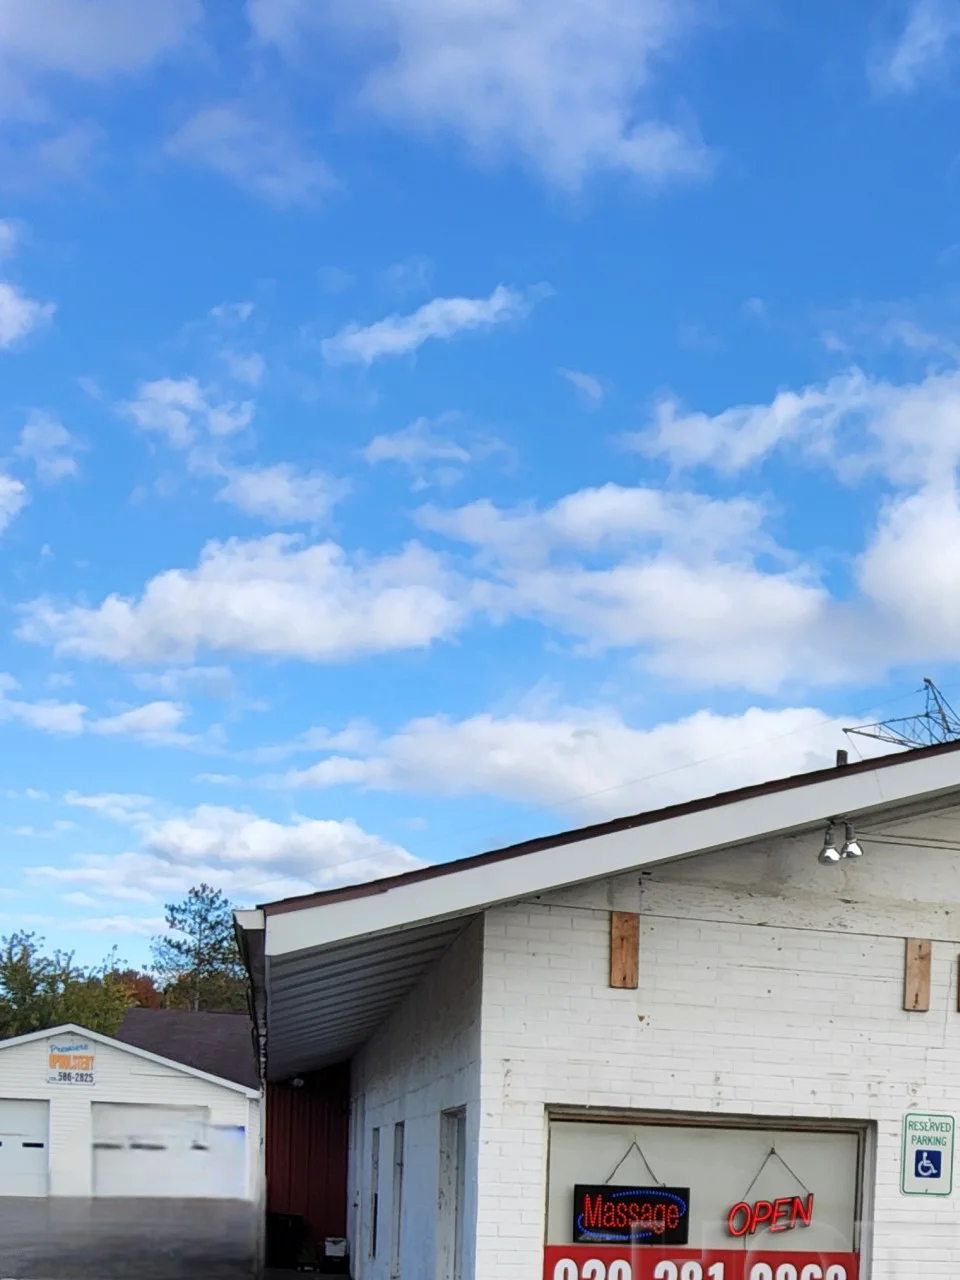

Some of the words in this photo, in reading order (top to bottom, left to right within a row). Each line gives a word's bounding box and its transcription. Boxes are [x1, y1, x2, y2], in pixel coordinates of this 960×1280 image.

[908, 1120, 952, 1133] RESERVED
[911, 1134, 947, 1147] PARKING
[583, 1193, 680, 1235] Massage
[726, 1192, 815, 1239] OPEN
